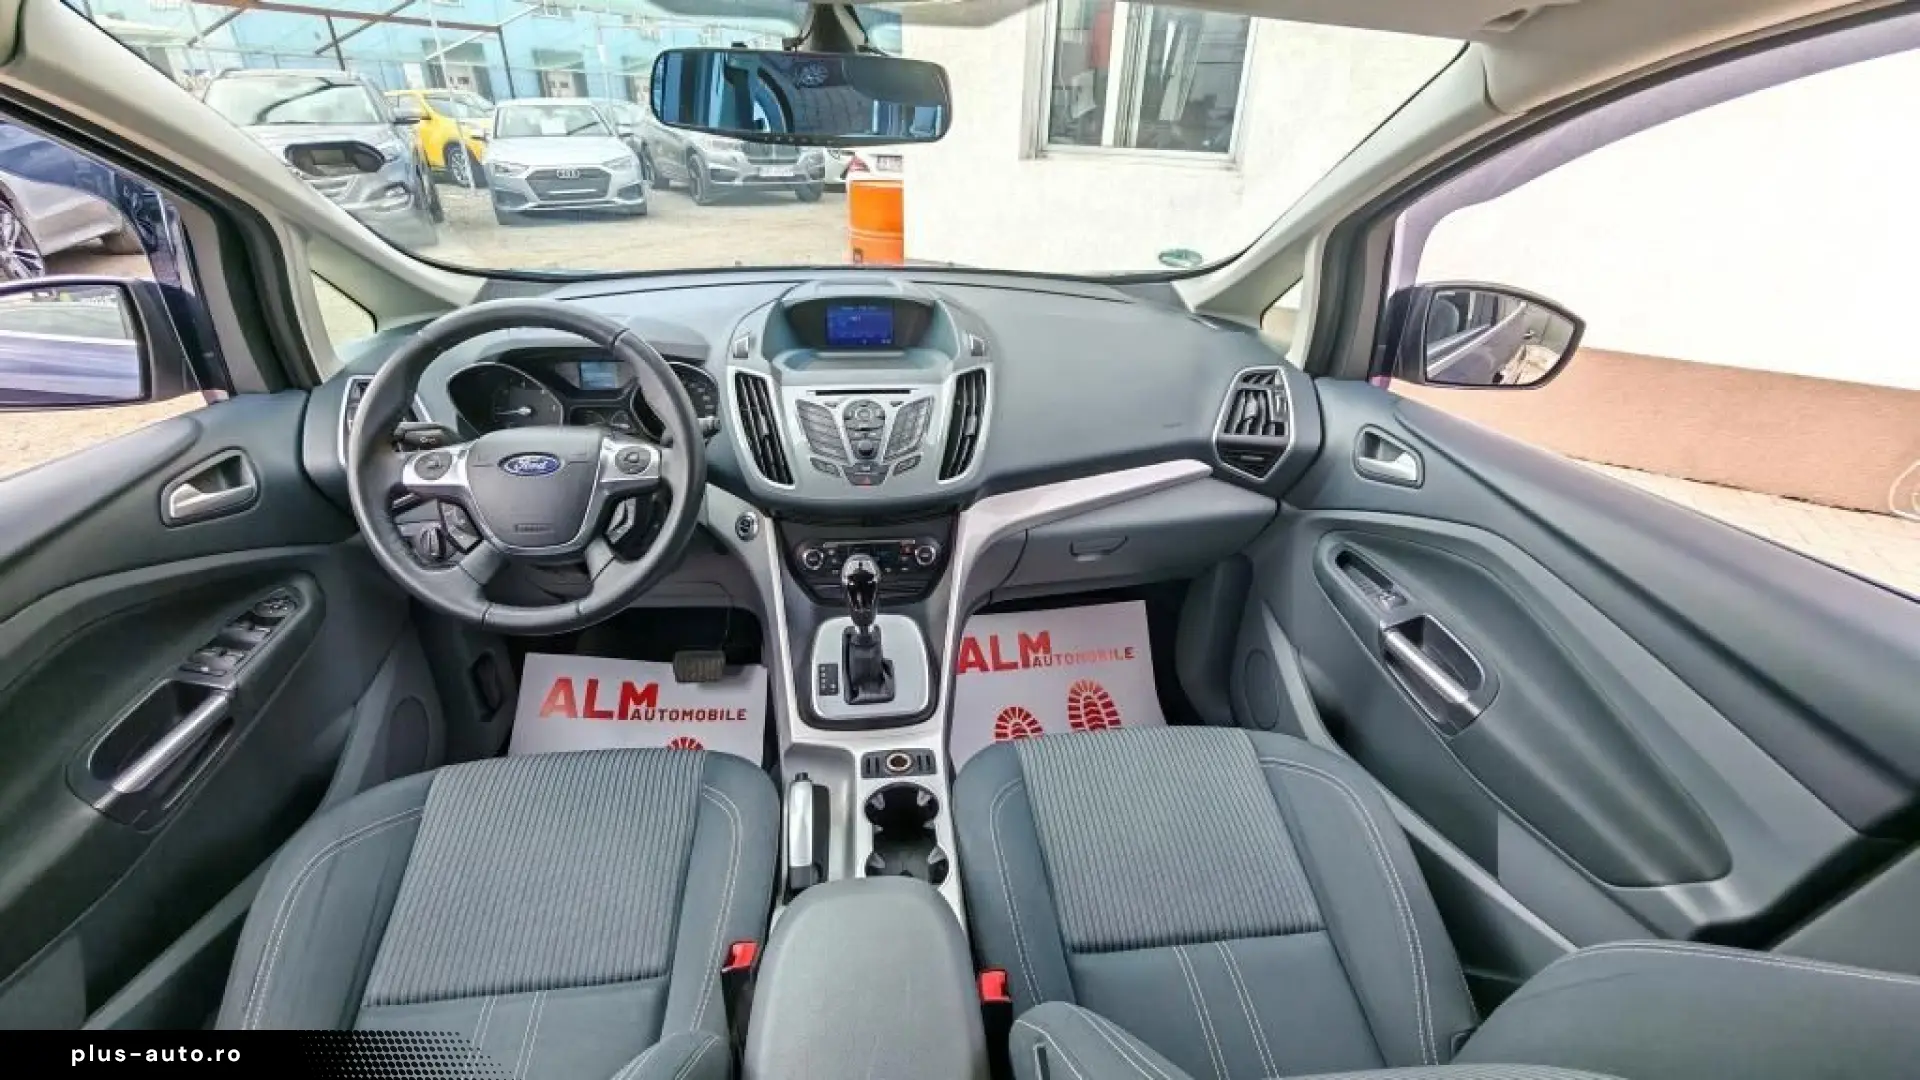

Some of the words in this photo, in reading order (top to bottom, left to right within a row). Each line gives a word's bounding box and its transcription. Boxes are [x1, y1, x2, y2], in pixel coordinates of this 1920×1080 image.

[507, 457, 551, 473] Ford
[957, 630, 1051, 674] ALM
[1032, 646, 1135, 668] AUTOMOBILE
[539, 676, 659, 720] ALM
[630, 707, 747, 722] AUTOMOBILE
